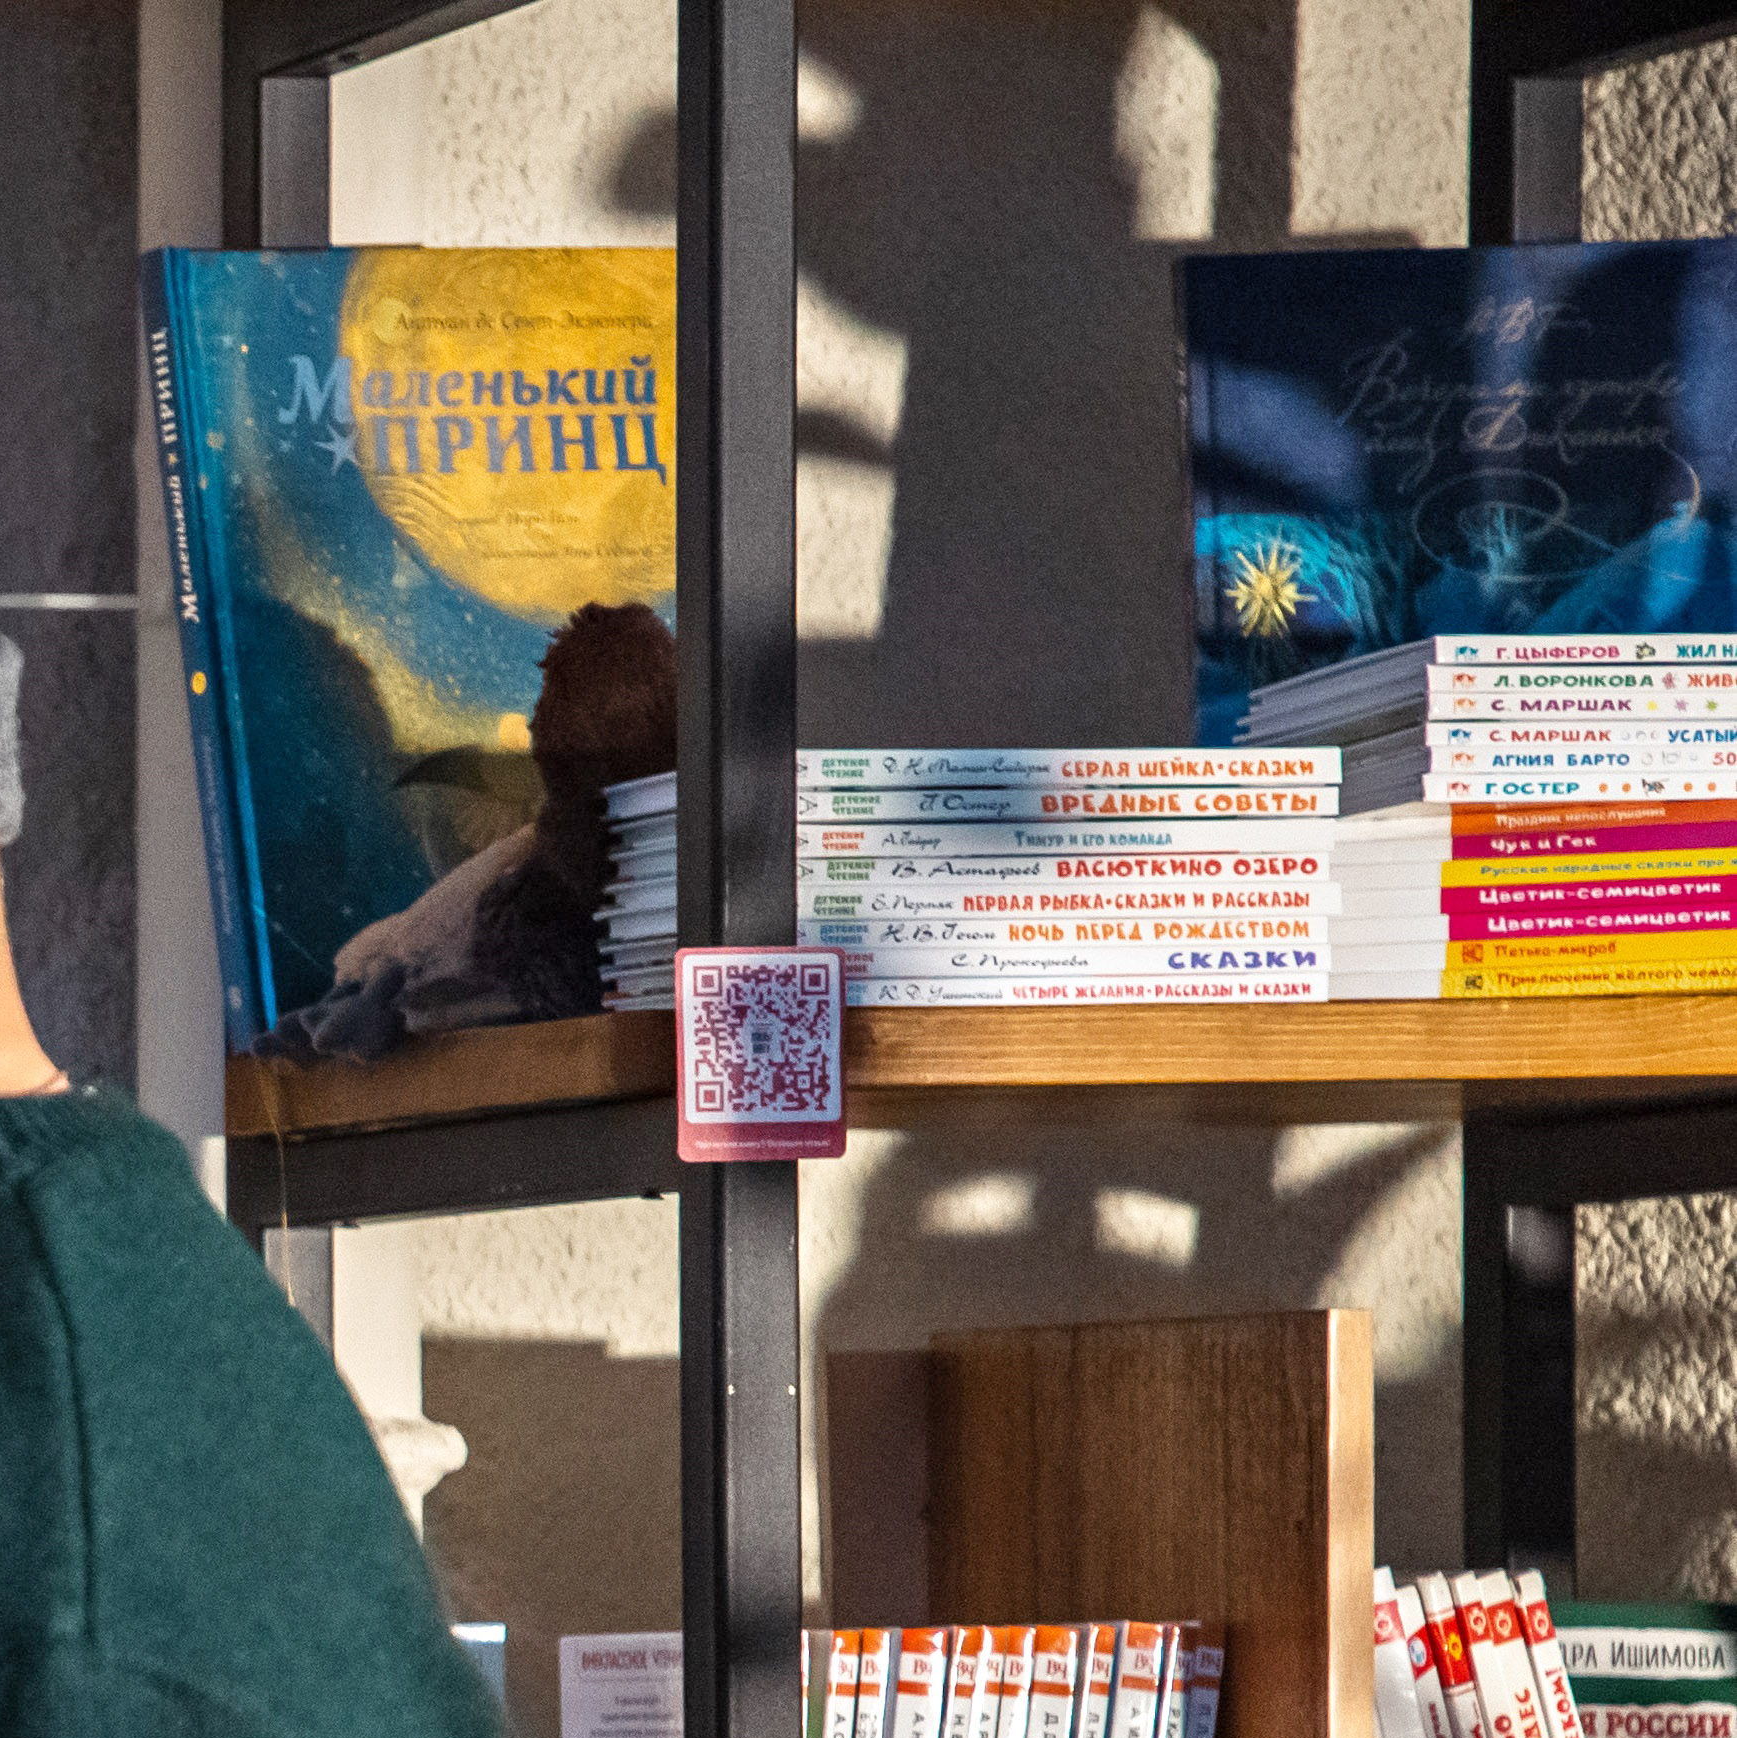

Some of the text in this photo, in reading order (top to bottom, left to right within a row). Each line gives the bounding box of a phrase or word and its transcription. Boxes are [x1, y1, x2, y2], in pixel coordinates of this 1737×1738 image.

[278, 354, 658, 425] Маленький
[366, 413, 667, 486] ПРИНЦ
[1514, 645, 1621, 660] ЦЫФЕРОВ
[1676, 644, 1717, 659] ЖИЛ
[1519, 674, 1654, 688] ВОРОНКОВА
[1061, 758, 1314, 778] СЕРАЯ ШЕЙКА СКАЗКИ
[1040, 793, 1317, 814] ВРЕДНЫЕ СОВЕТЫ
[1490, 838, 1532, 855] Чук
[1557, 835, 1597, 849] Гек
[1056, 857, 1319, 878] ВАСЮТКИНО ОЗЕРО
[963, 891, 1310, 911] ПЕРВАЯ РЫБКА СКАЗКИ И РАССКАЗЫ
[1479, 882, 1722, 905] Цветик-семицветик
[1008, 920, 1310, 942] НОЧЬ ПЕРЕД РОЖДЕСТВОМ
[1488, 909, 1731, 933] Цветик-семицветик
[1167, 951, 1317, 970] СКАЗКИ
[1154, 984, 1233, 998] РАССКАЗЫ
[1610, 1640, 1726, 1669] ИШИМОВА
[1606, 1711, 1731, 1738] РОССИИ
